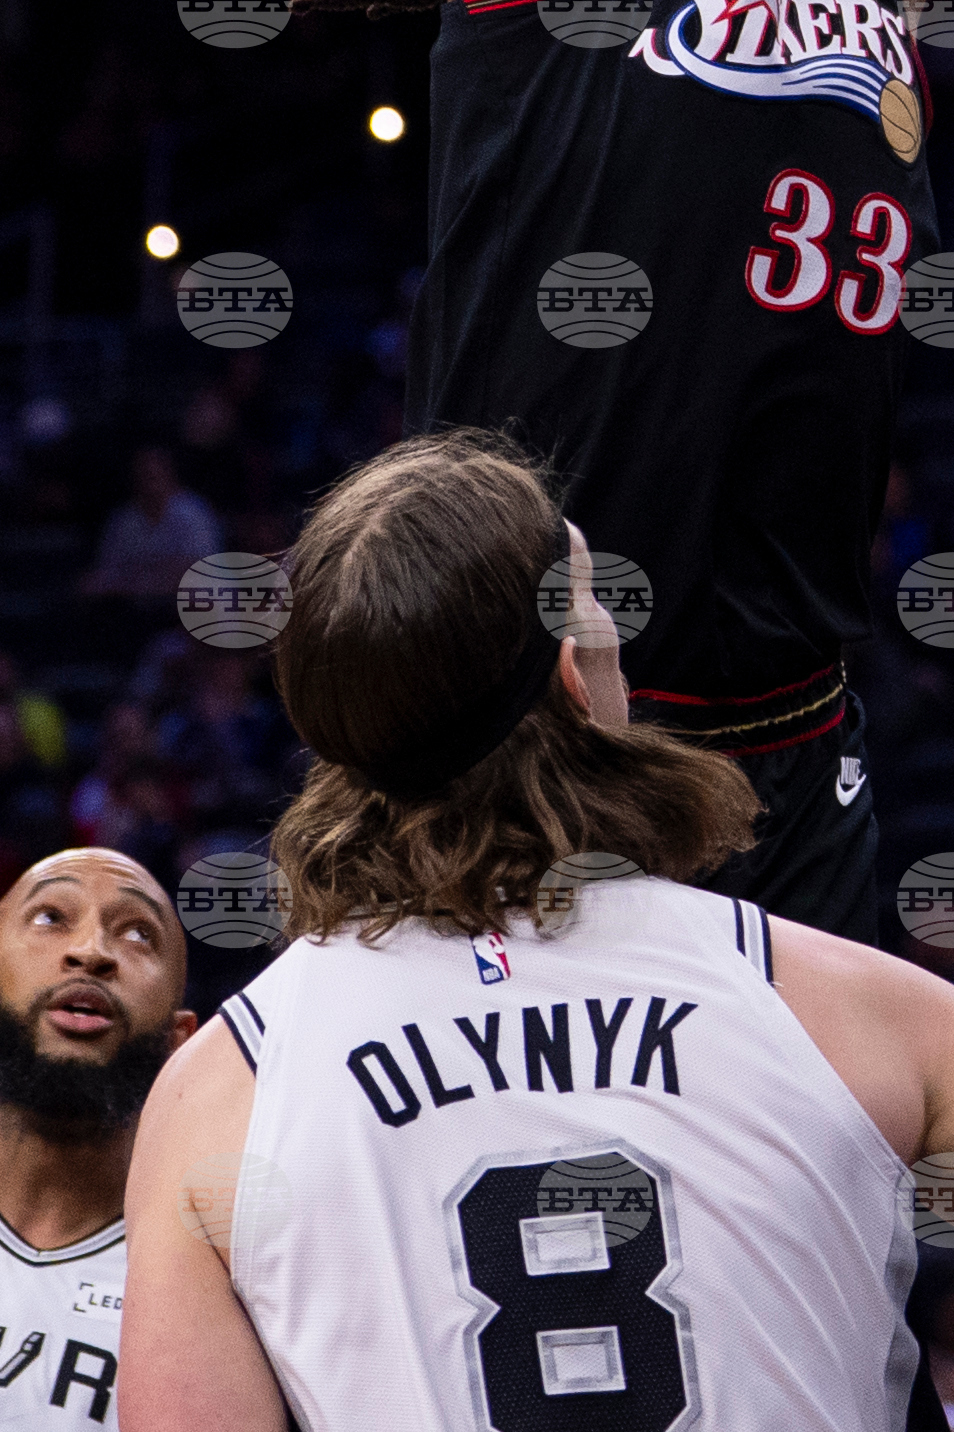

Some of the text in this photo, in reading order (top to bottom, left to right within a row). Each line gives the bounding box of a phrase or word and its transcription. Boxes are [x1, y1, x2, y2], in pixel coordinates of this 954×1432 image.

[745, 168, 912, 336] 33
[346, 996, 699, 1128] OLYNYK
[442, 1137, 703, 1432] 8
